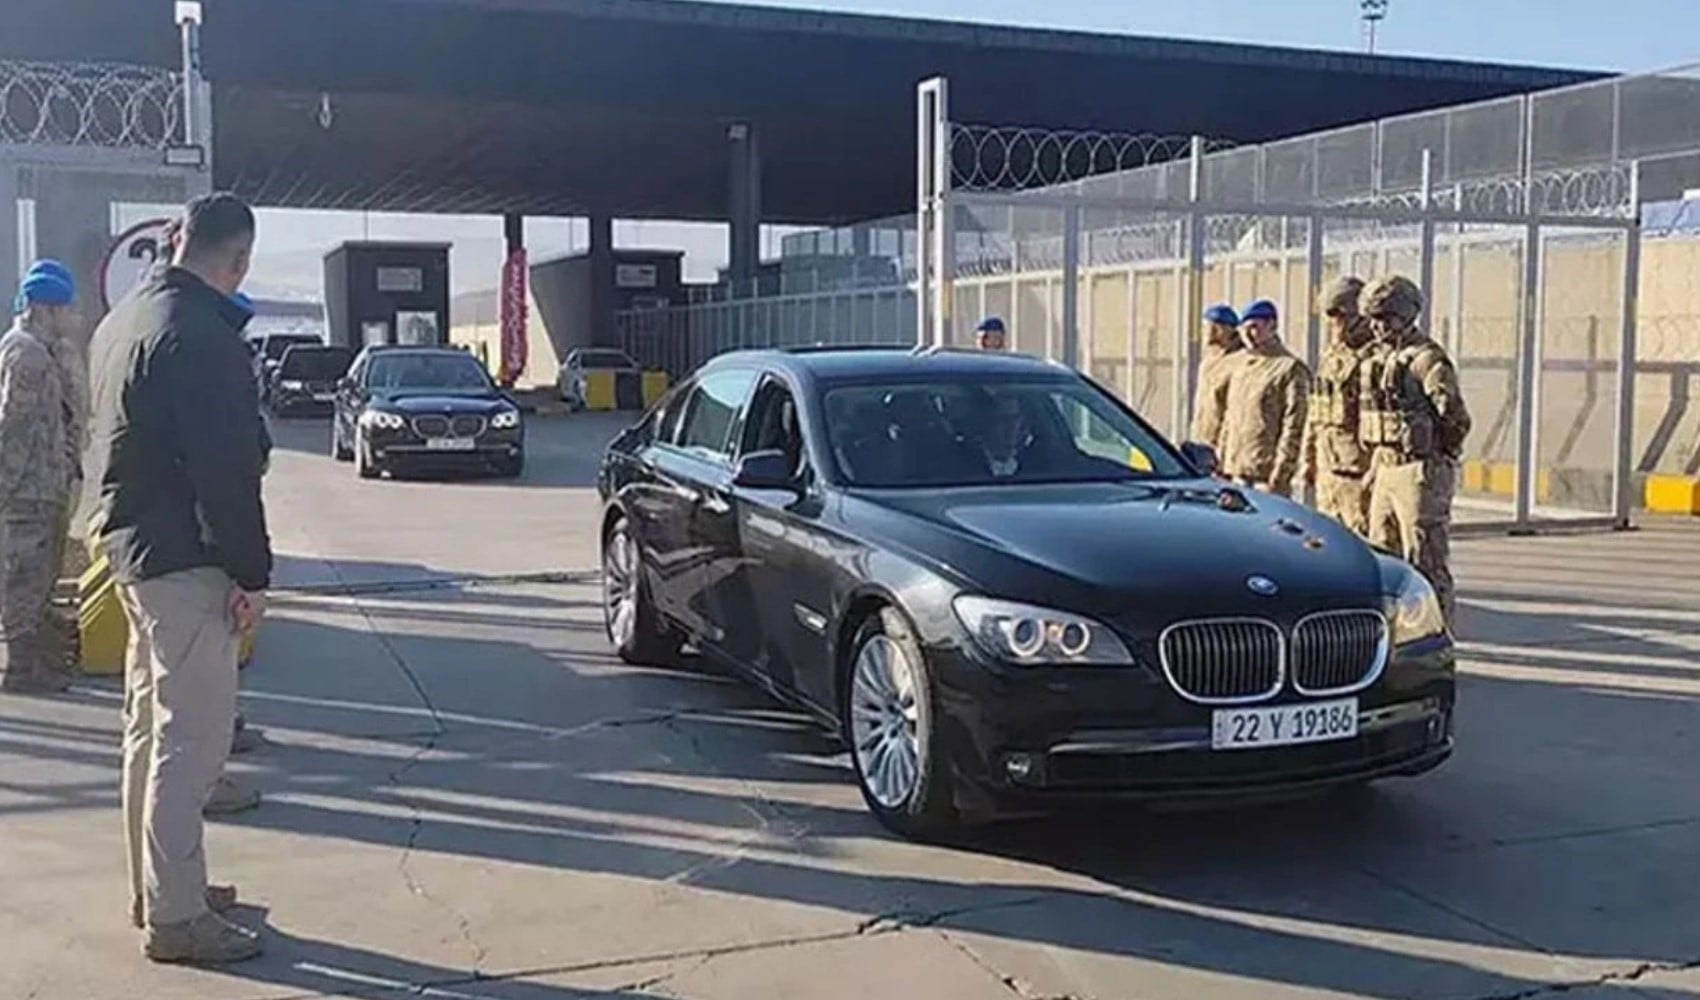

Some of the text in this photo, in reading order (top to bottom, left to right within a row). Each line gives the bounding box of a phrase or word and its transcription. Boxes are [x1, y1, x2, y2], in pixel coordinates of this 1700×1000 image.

[1232, 714, 1261, 742] 22
[1269, 711, 1285, 739] Y
[1292, 704, 1353, 738] 19186
